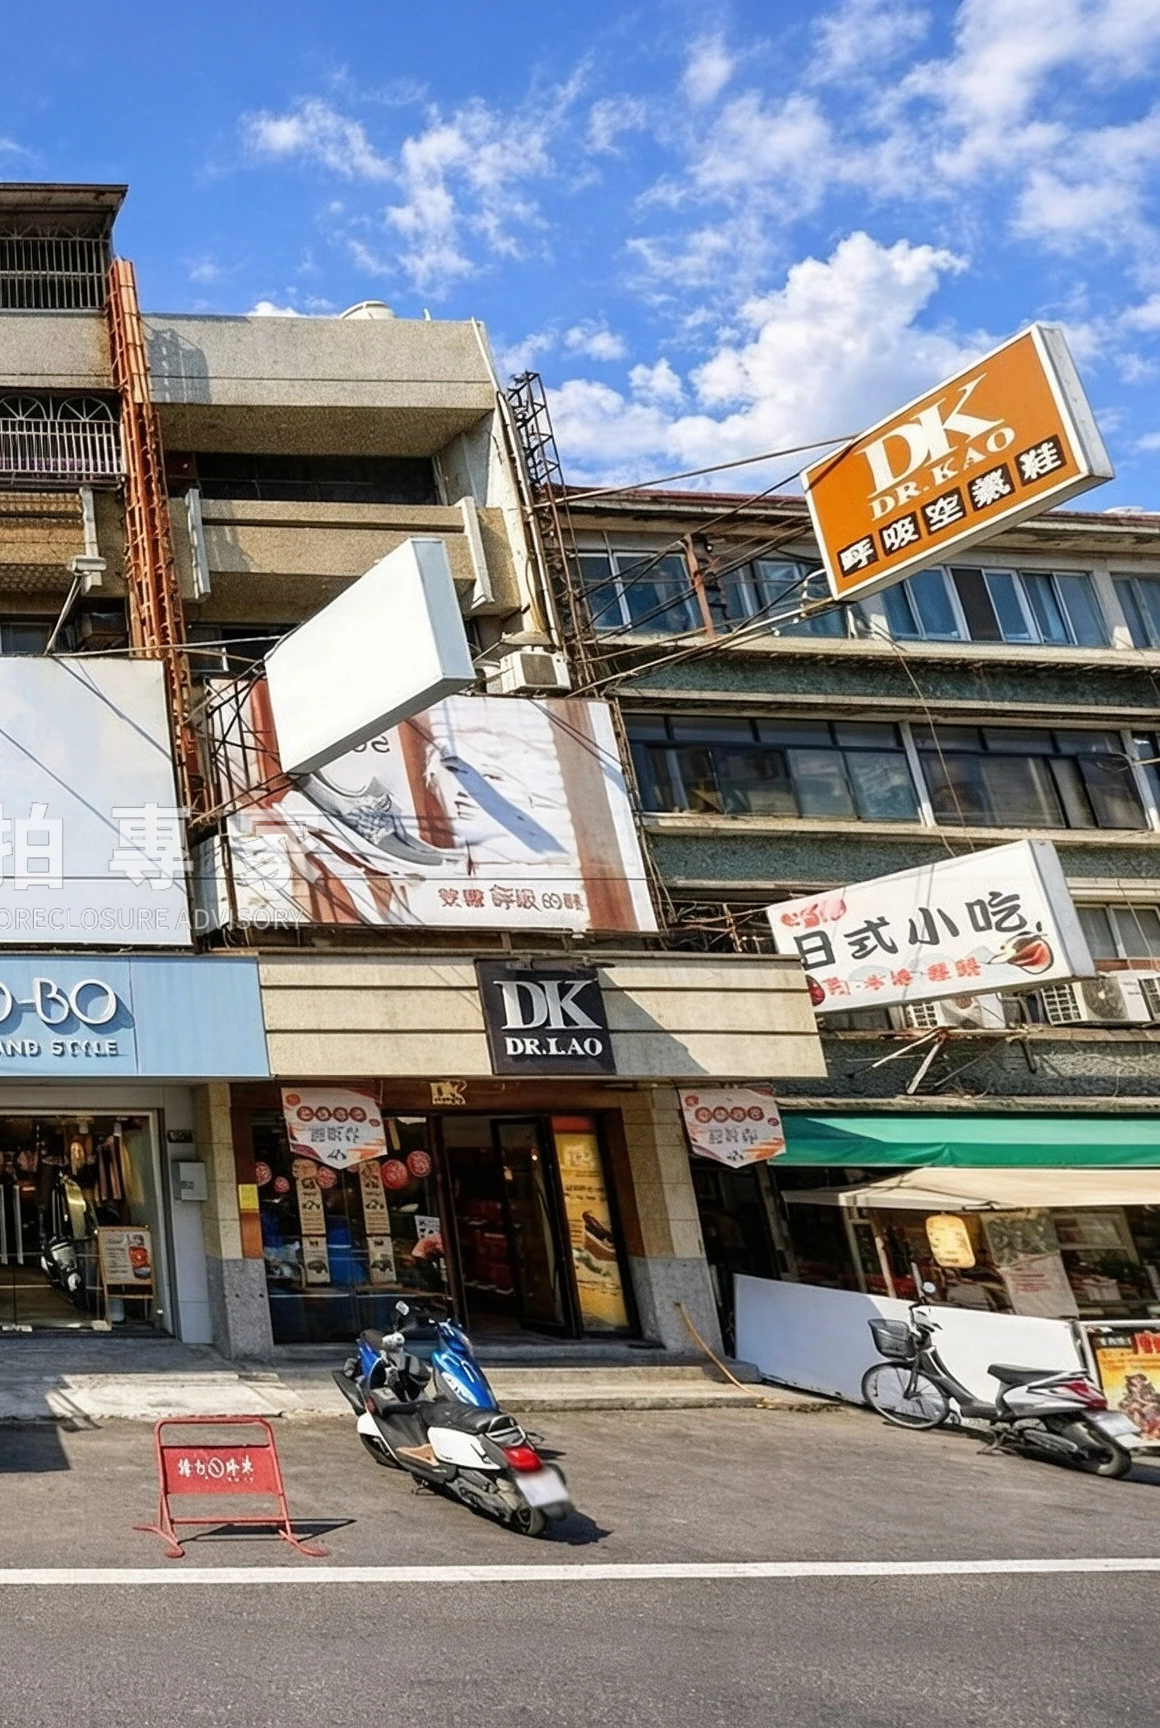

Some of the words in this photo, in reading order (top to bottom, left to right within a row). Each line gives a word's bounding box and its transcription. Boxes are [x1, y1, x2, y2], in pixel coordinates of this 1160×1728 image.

[853, 371, 1005, 499] DK
[793, 890, 1030, 971] 日式小吃
[493, 978, 603, 1030] DK
